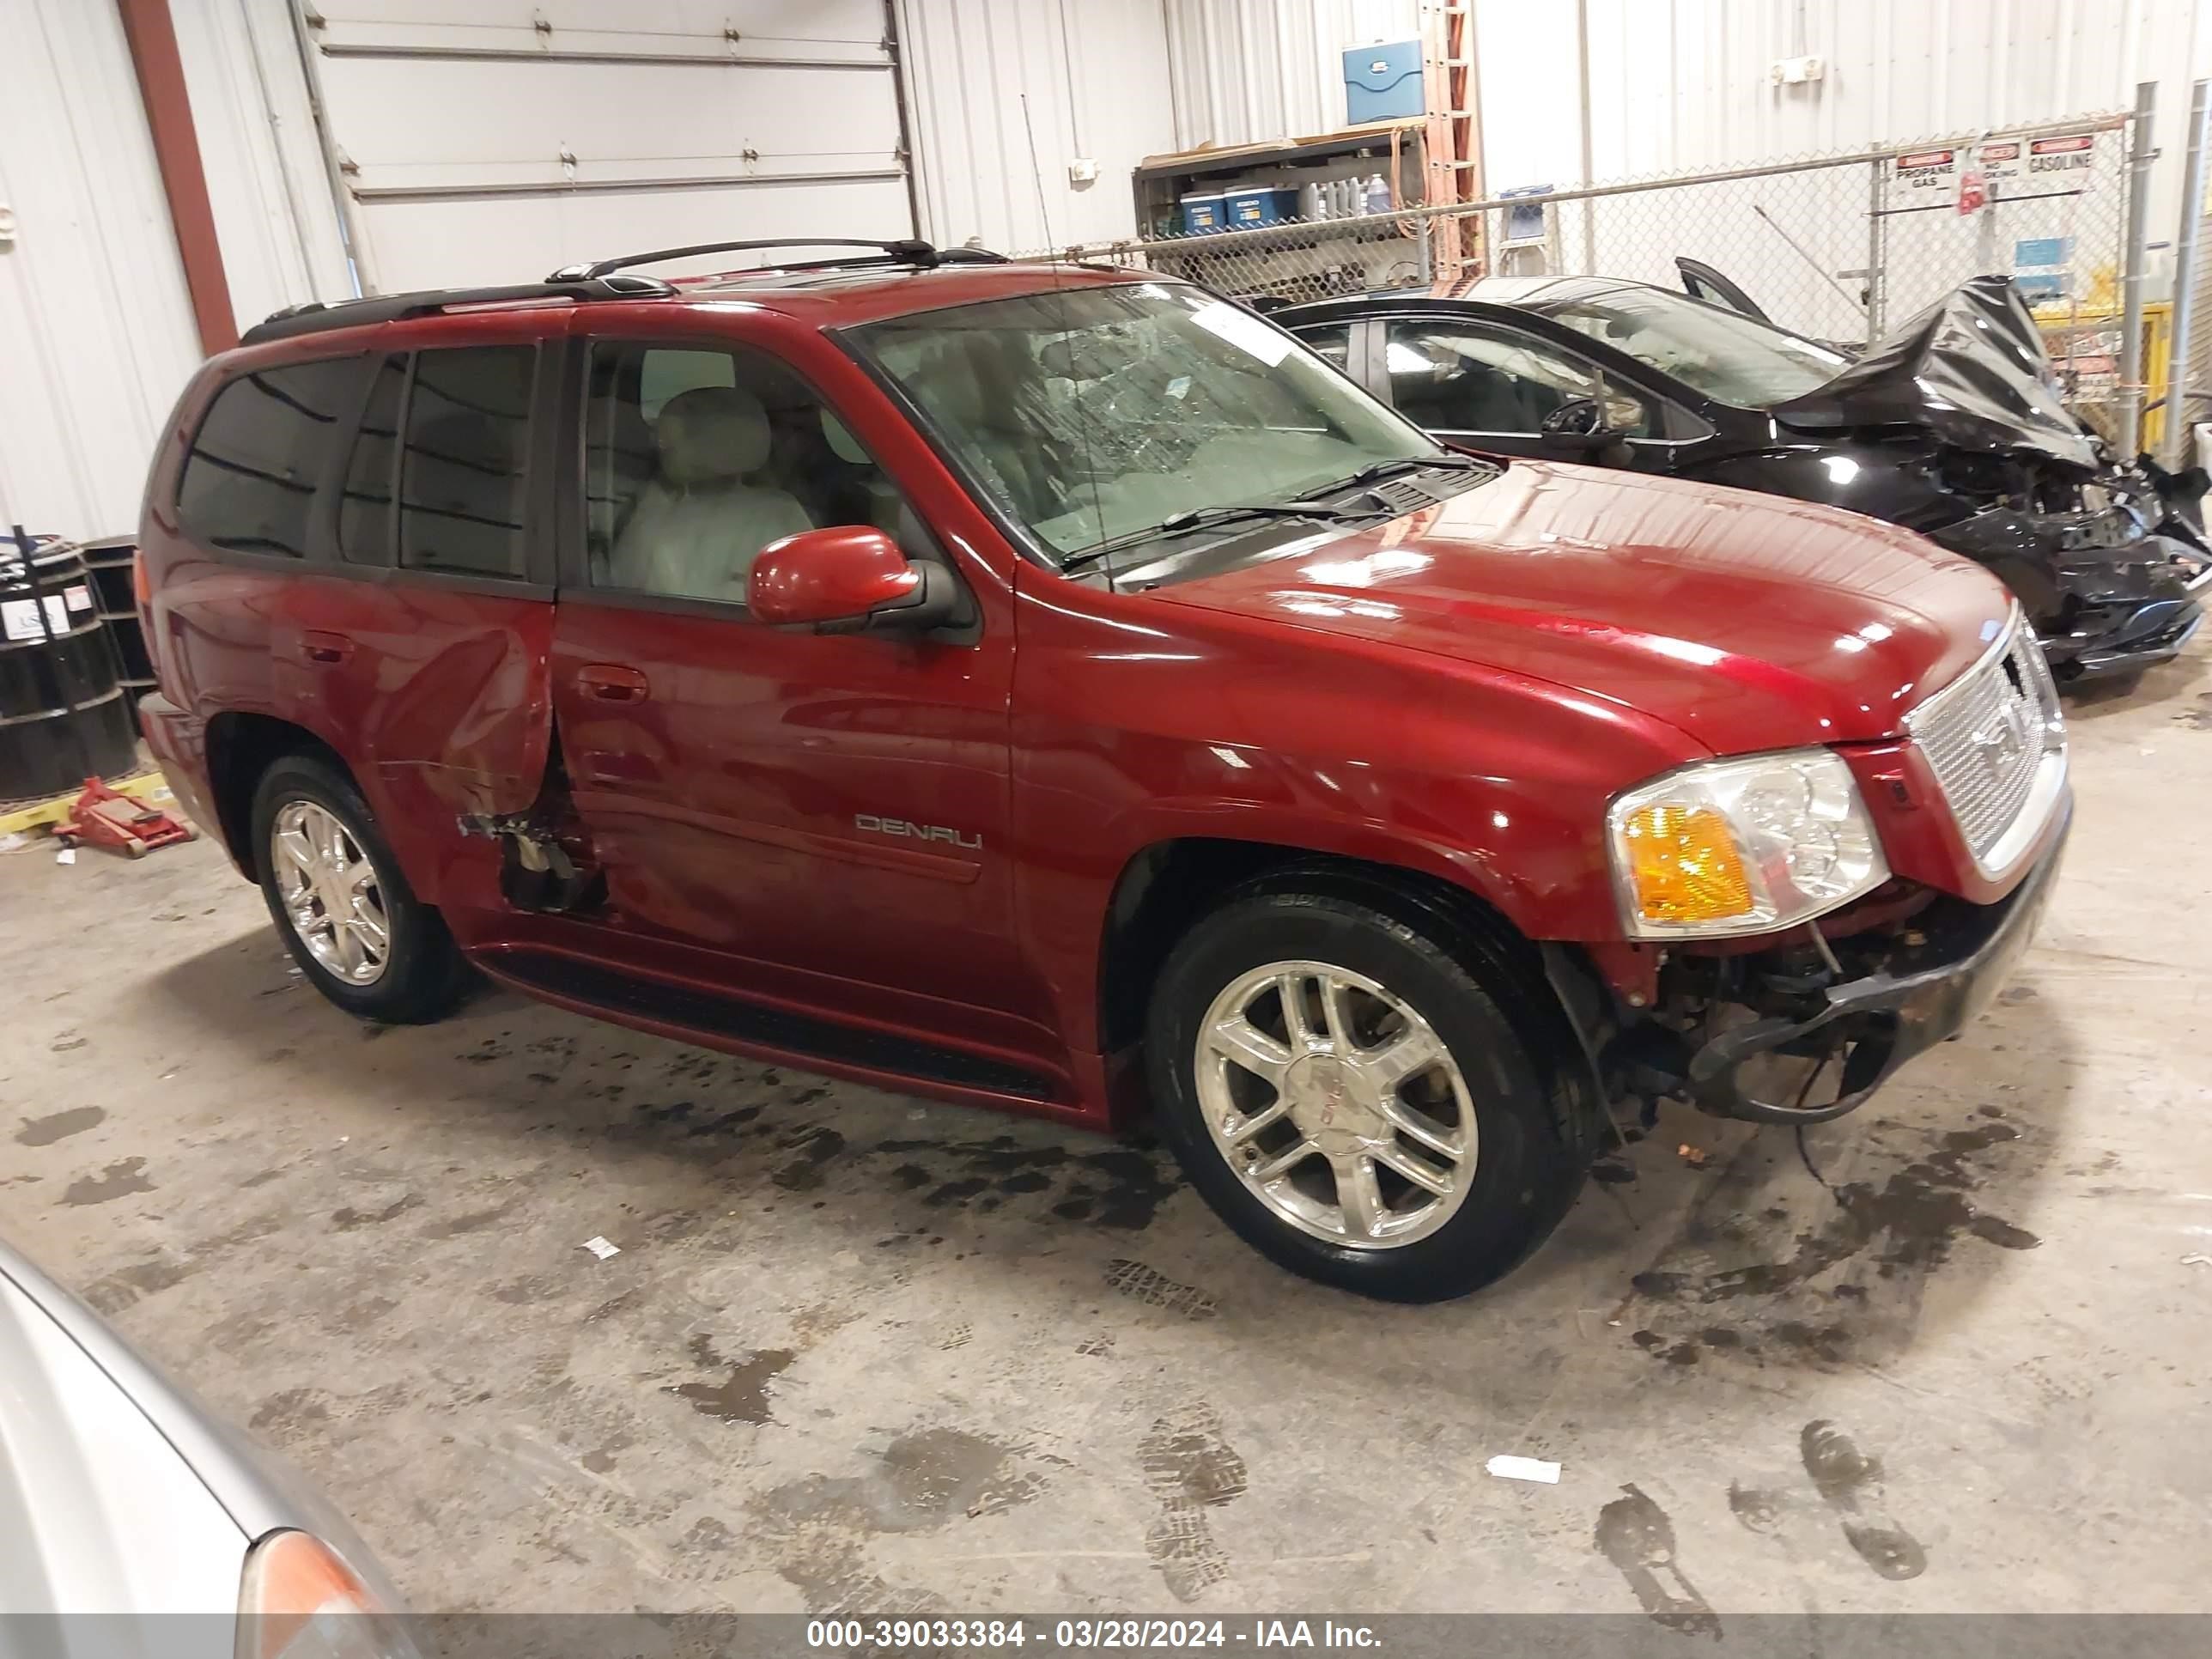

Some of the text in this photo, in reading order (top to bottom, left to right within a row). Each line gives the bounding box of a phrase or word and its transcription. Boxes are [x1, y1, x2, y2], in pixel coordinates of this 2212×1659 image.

[1897, 164, 1954, 180] PROPANE
[2029, 153, 2092, 173] GASOLINE
[1911, 177, 1938, 188] GAS
[855, 813, 983, 850] DENALI
